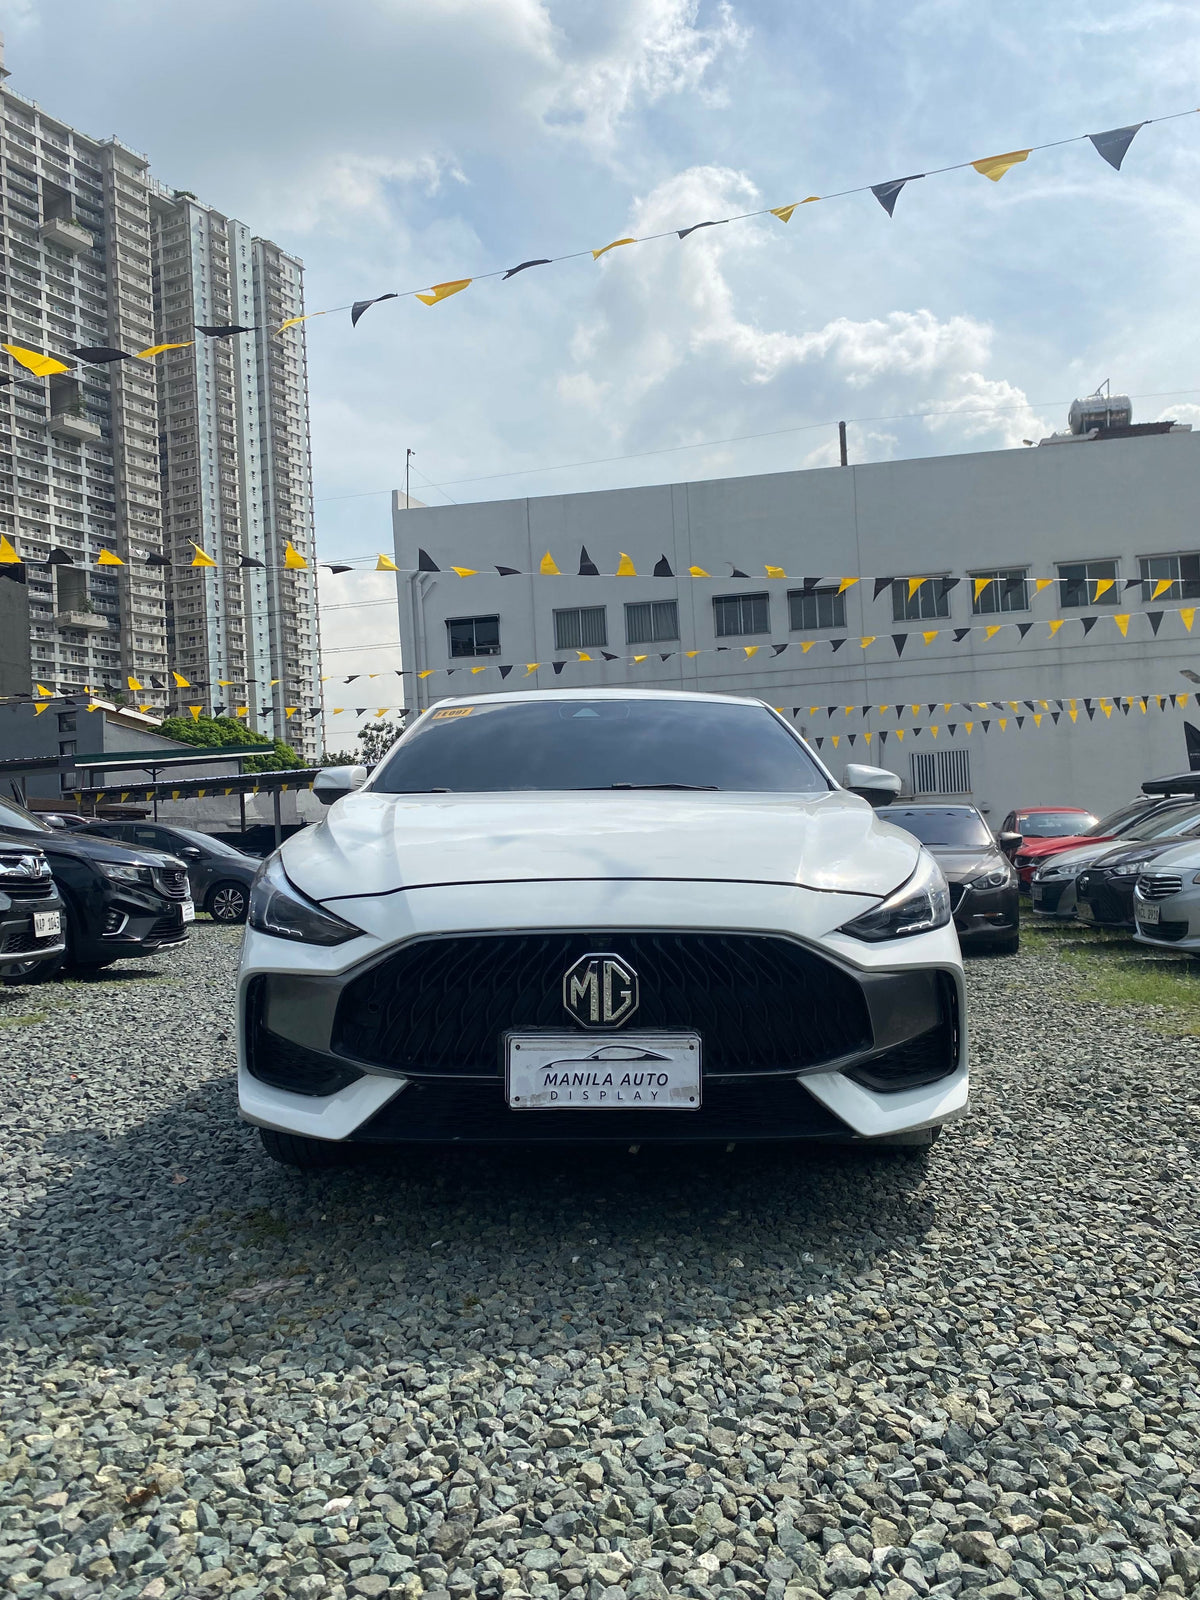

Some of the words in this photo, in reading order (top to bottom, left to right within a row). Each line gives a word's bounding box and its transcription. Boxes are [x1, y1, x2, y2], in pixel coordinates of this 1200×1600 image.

[570, 960, 632, 1022] MG
[543, 1073, 613, 1086] MANILA
[620, 1073, 669, 1086] AUTO
[550, 1090, 659, 1101] DISPLAY
